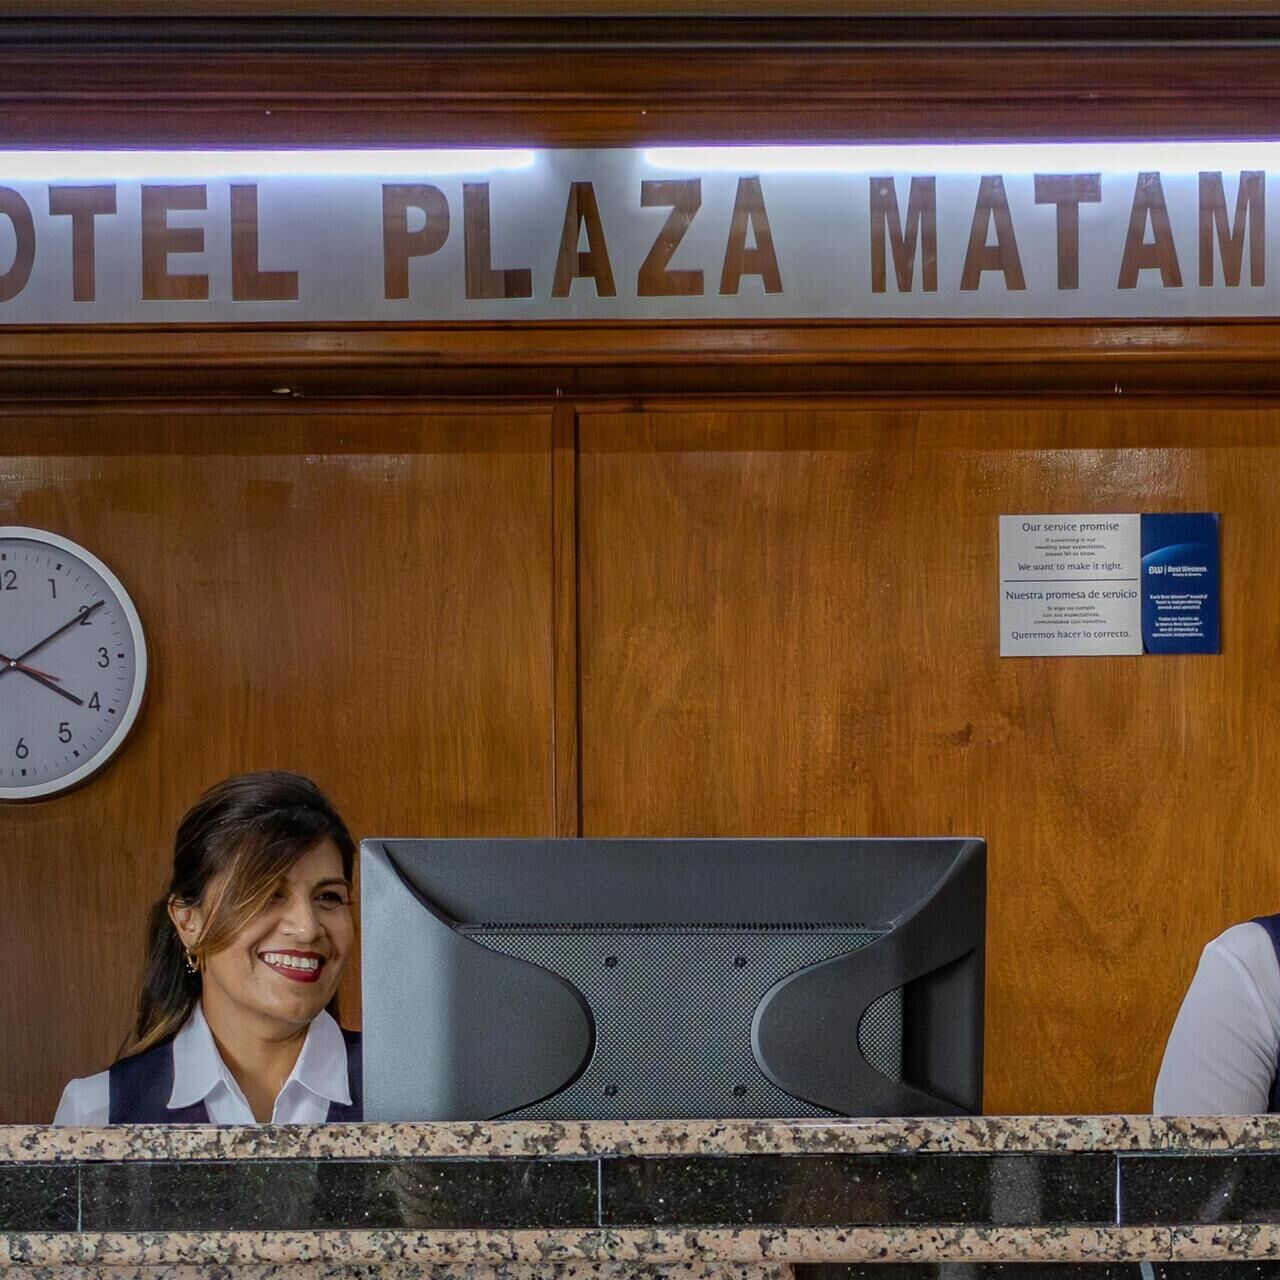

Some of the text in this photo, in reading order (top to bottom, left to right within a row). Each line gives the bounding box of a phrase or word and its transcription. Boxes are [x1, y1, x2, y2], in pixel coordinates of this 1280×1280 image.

[381, 175, 784, 300] PLAZA
[1022, 521, 1119, 533] Our service promise
[1018, 563, 1031, 571] We
[1067, 562, 1090, 570] make
[1101, 562, 1123, 572] right.
[1148, 566, 1163, 574] BW
[48, 578, 57, 599] 1
[1006, 589, 1137, 601] Nuestra promesa de servicio
[1011, 630, 1131, 640] Queremos hacer lo correcto.
[97, 647, 110, 668] 3
[88, 691, 102, 712] 4
[58, 722, 72, 743] 5
[16, 737, 29, 759] 6
